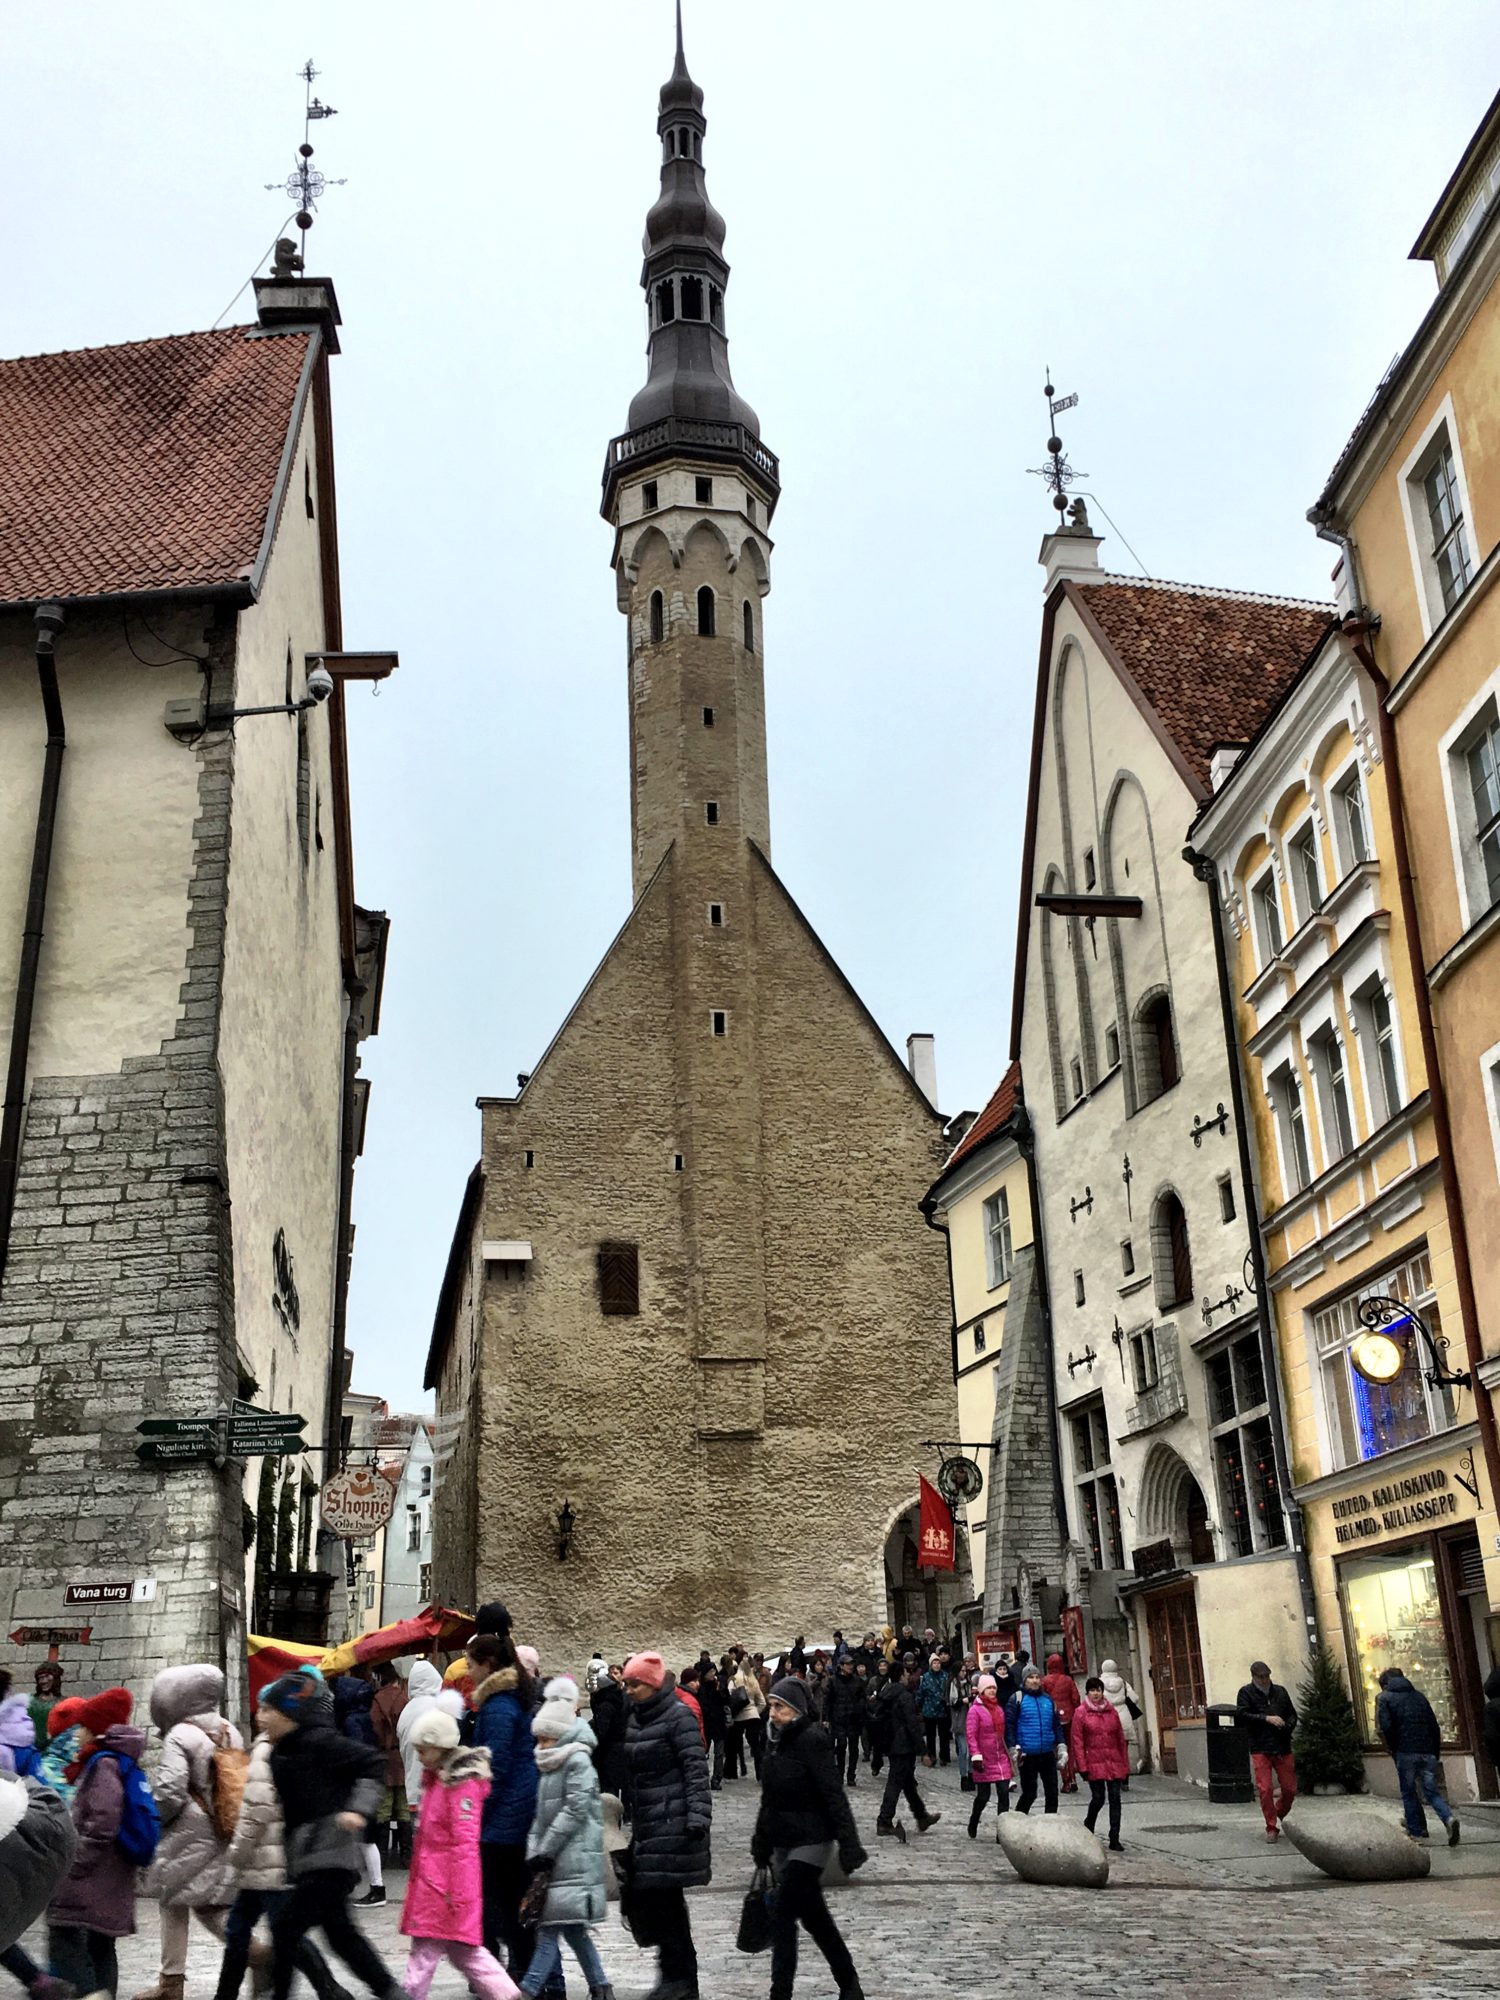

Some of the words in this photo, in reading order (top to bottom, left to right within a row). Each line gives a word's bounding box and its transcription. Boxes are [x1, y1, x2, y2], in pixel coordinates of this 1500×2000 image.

[156, 1443, 190, 1451] Niguliste
[232, 1440, 266, 1448] Katariina
[1372, 1469, 1446, 1507] KALLISKIVID
[324, 1488, 389, 1520] Shoppe
[1382, 1493, 1456, 1530] KULLASSEPP
[72, 1587, 100, 1598] Vana
[103, 1586, 127, 1598] turg
[141, 1585, 147, 1596] 1
